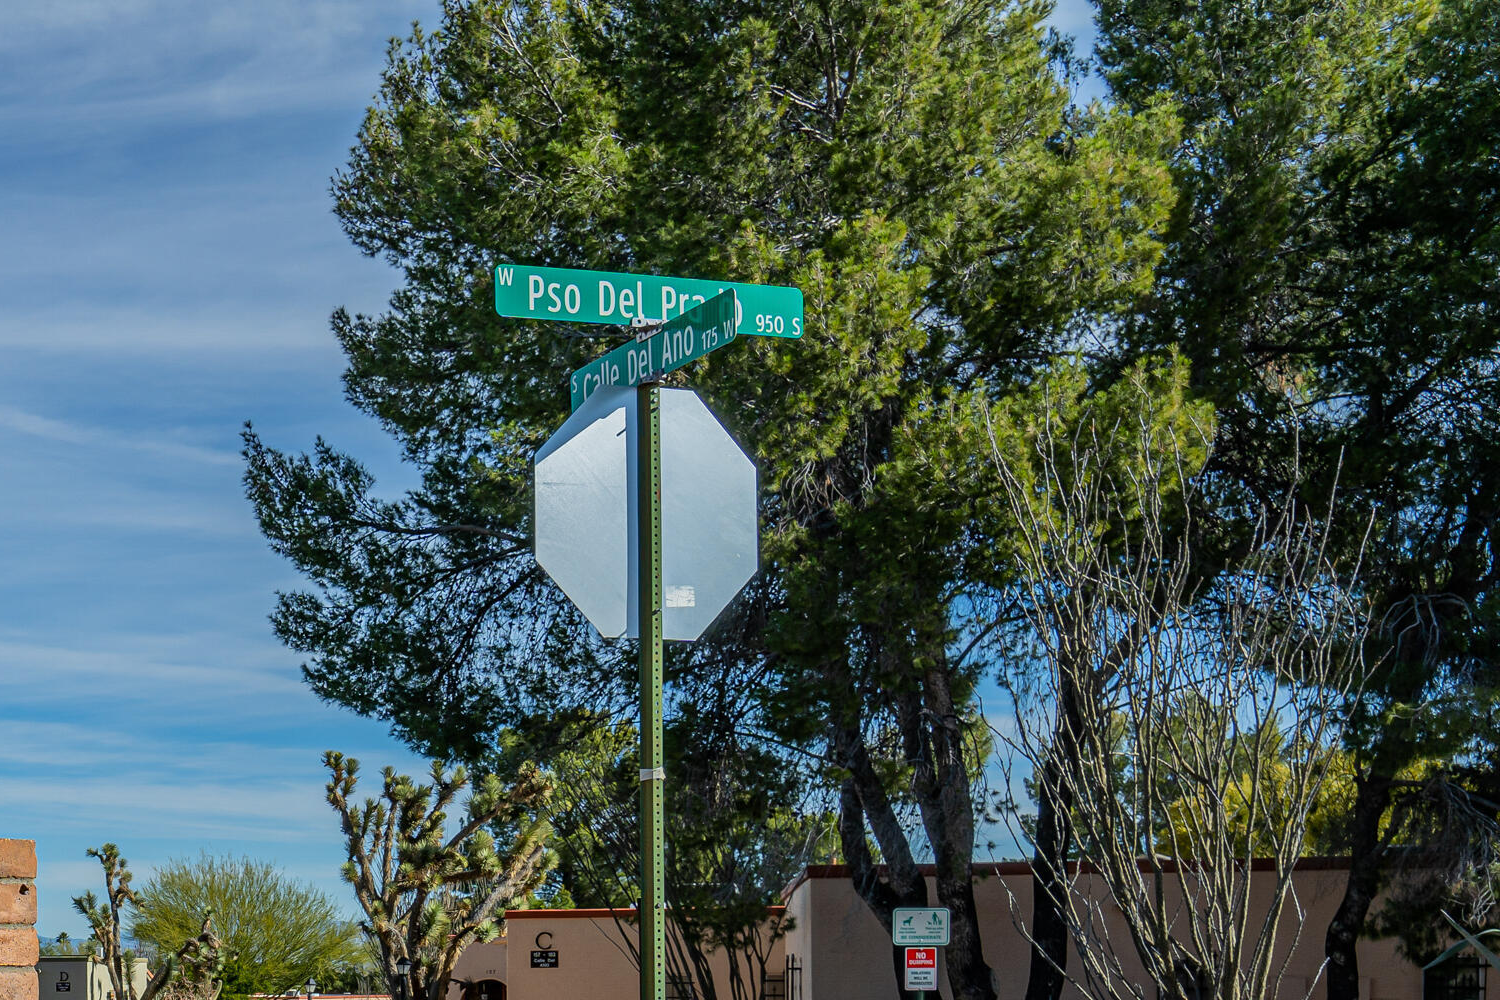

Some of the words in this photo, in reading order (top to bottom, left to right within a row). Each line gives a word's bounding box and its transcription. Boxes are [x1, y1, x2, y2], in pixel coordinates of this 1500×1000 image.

[498, 267, 514, 286] W
[528, 275, 581, 314] Pso
[598, 280, 645, 319] Del
[755, 314, 784, 334] 950
[792, 317, 801, 336] S
[571, 375, 579, 394] S
[627, 339, 654, 386] Del
[662, 325, 694, 369] Ano
[701, 326, 718, 351] 175
[723, 317, 735, 340] W
[535, 931, 553, 950] C
[60, 971, 69, 981] D
